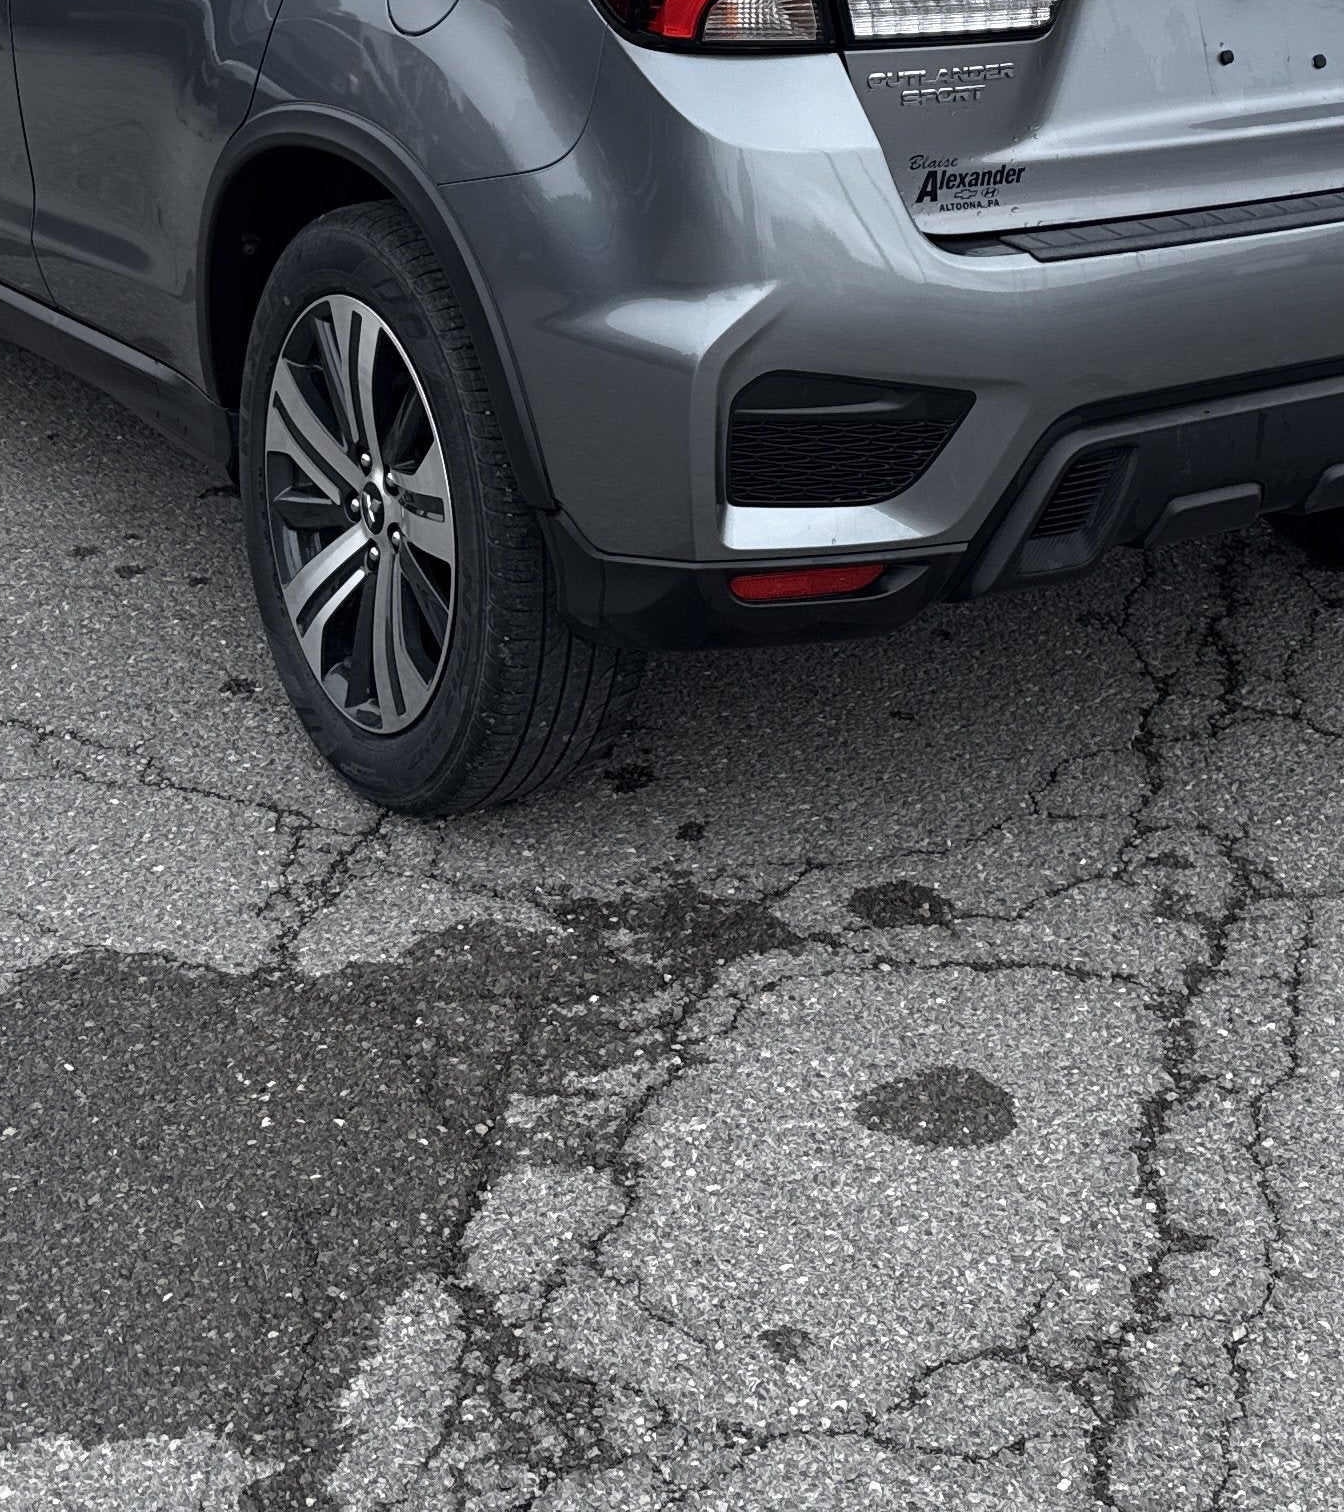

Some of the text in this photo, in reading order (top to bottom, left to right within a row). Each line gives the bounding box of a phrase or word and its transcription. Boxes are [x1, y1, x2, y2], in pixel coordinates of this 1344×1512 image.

[867, 62, 1016, 88] OUTLANDER
[900, 84, 986, 107] SPORT
[909, 154, 959, 170] Blaise
[915, 164, 1026, 203] Alexander
[987, 198, 1001, 208] PA
